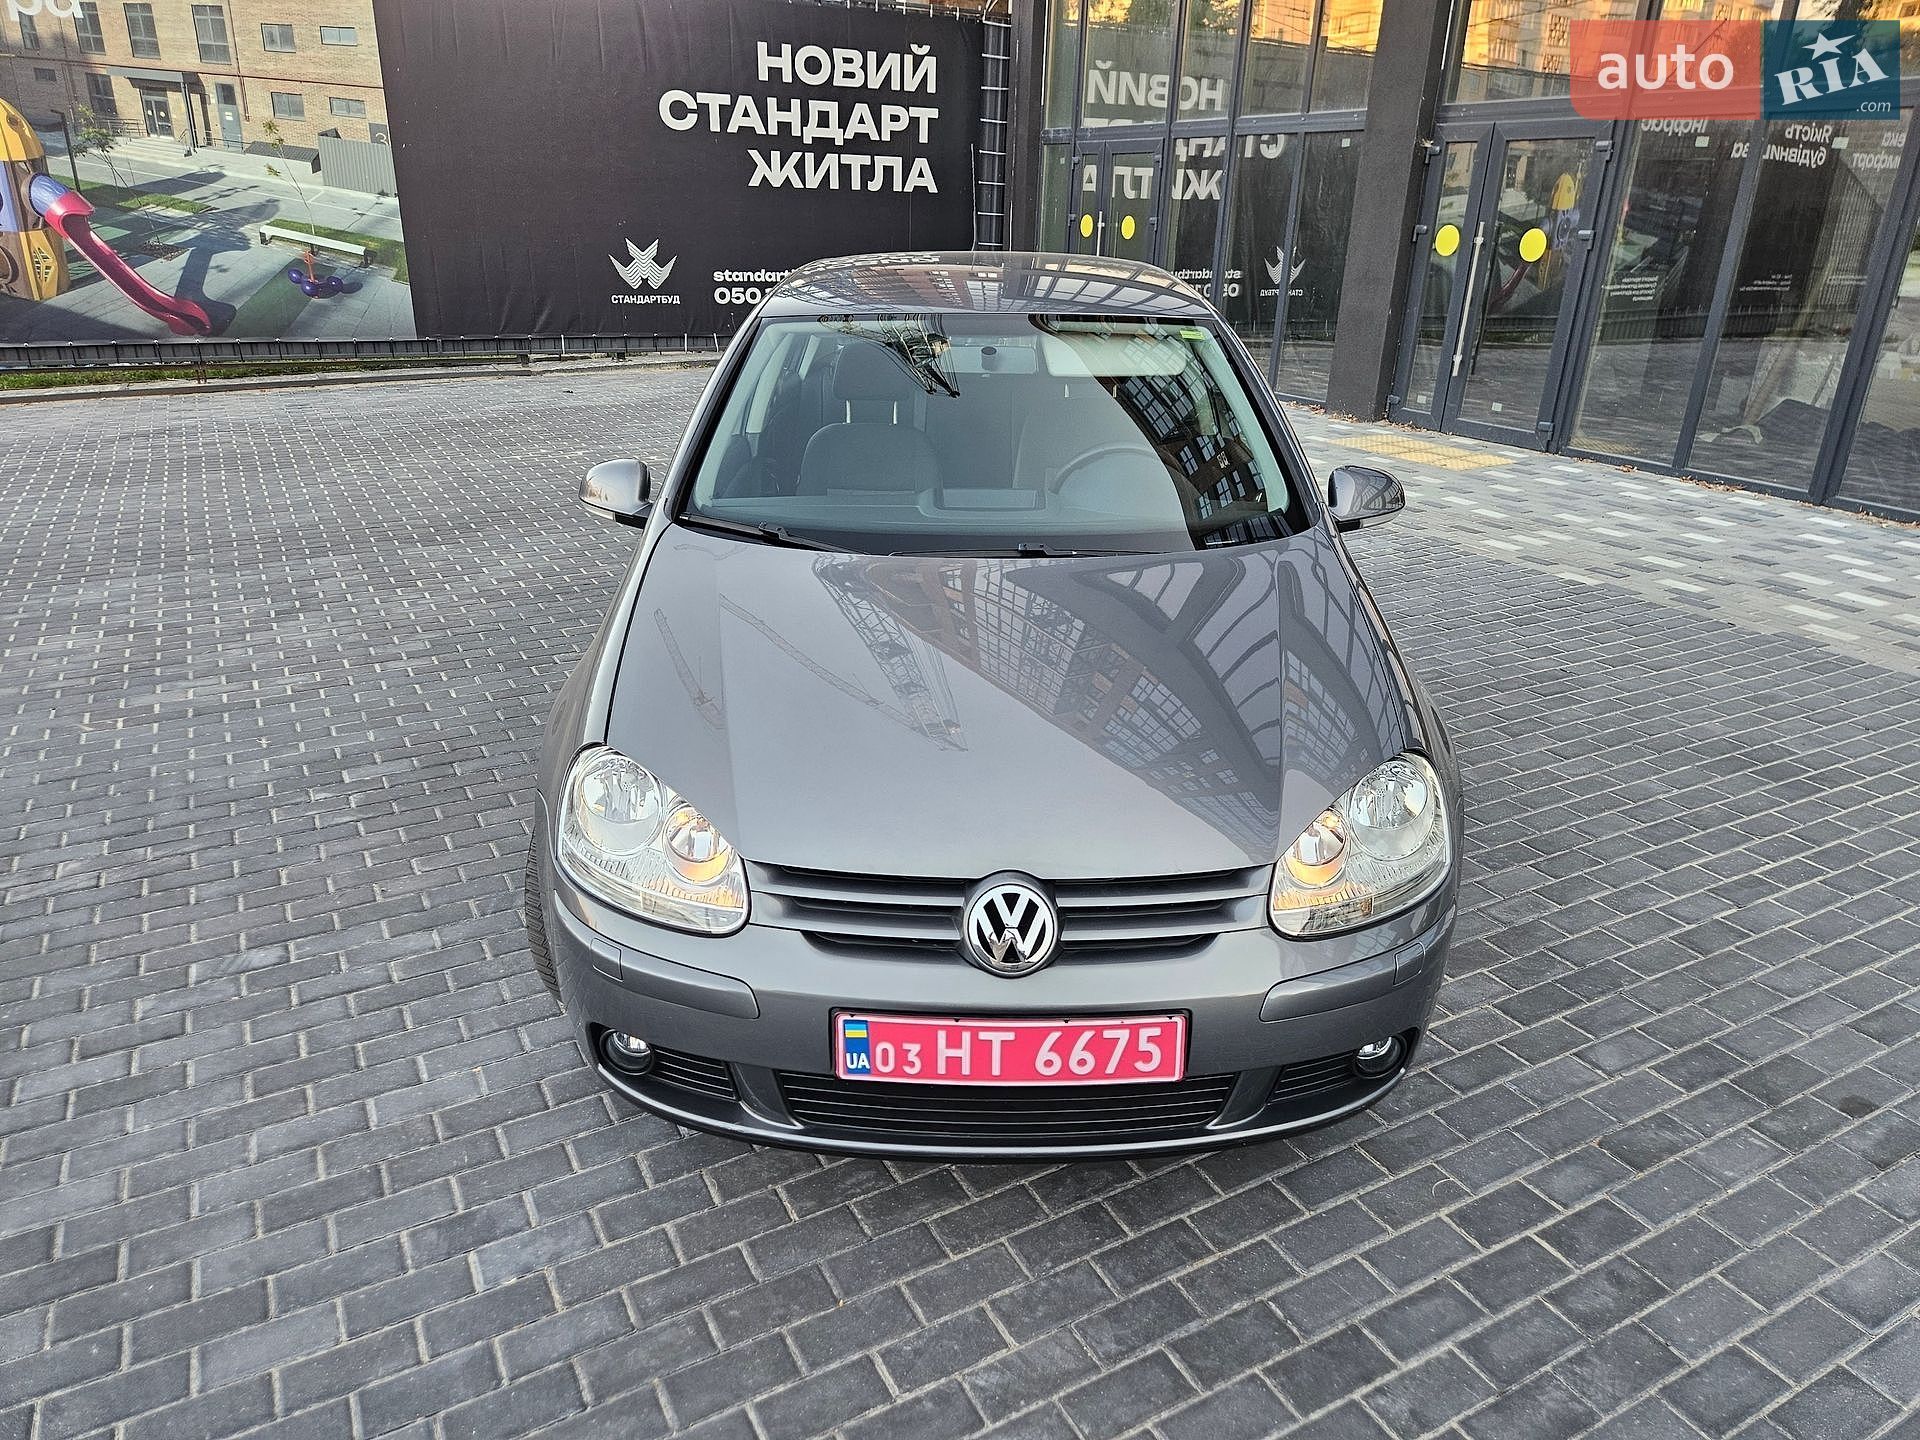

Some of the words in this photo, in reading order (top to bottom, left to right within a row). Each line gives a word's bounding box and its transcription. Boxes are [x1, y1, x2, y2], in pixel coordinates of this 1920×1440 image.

[757, 42, 938, 93] НОВИЙ
[658, 89, 939, 145] СТАНДАРТ
[747, 149, 938, 193] ЖИТЛА
[611, 295, 680, 304] СТАНДАРТБУД
[714, 287, 761, 304] 050
[846, 1052, 870, 1070] UA
[875, 1041, 922, 1075] 03
[936, 1030, 1016, 1076] HT
[1034, 1027, 1162, 1076] 6675
